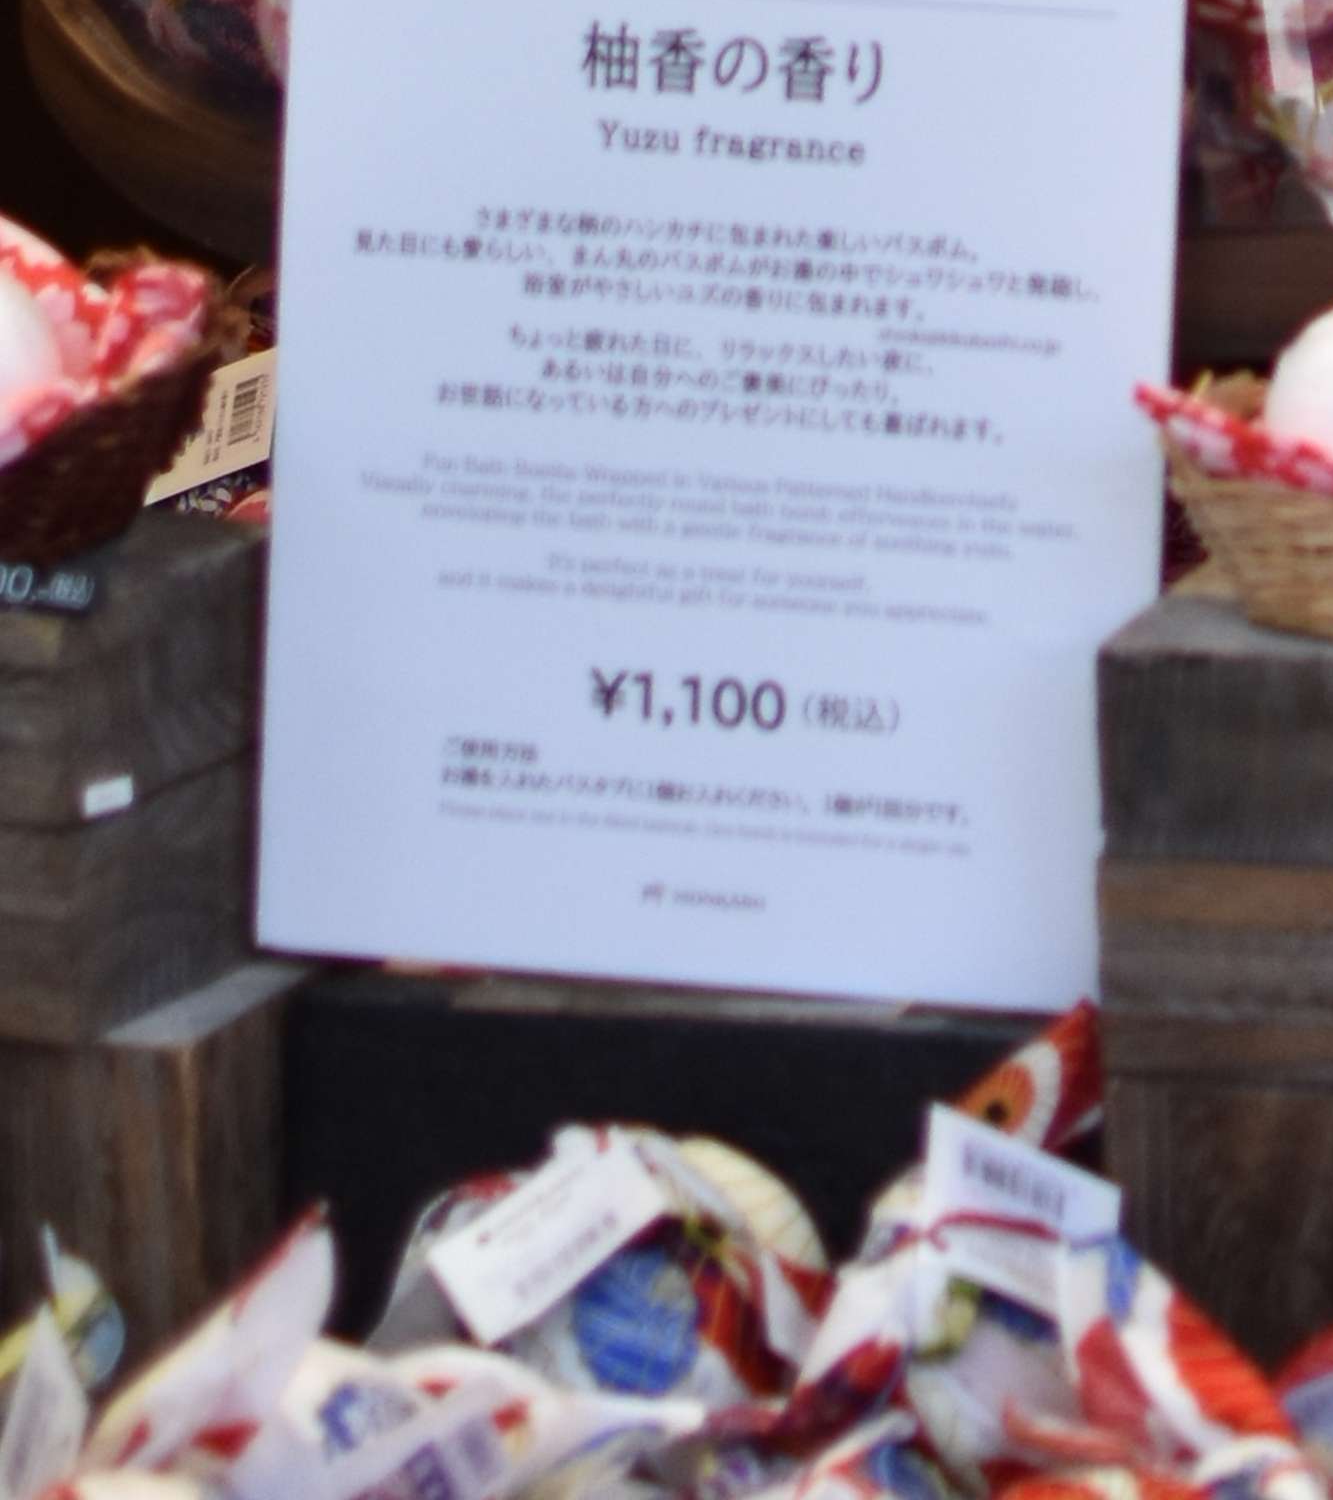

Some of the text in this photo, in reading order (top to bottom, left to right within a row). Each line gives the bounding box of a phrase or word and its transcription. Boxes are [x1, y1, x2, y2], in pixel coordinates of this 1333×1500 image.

[580, 18, 886, 105] 柚香の香り
[597, 118, 867, 167] Yuzu fragrance
[588, 667, 788, 732] ¥1,100
